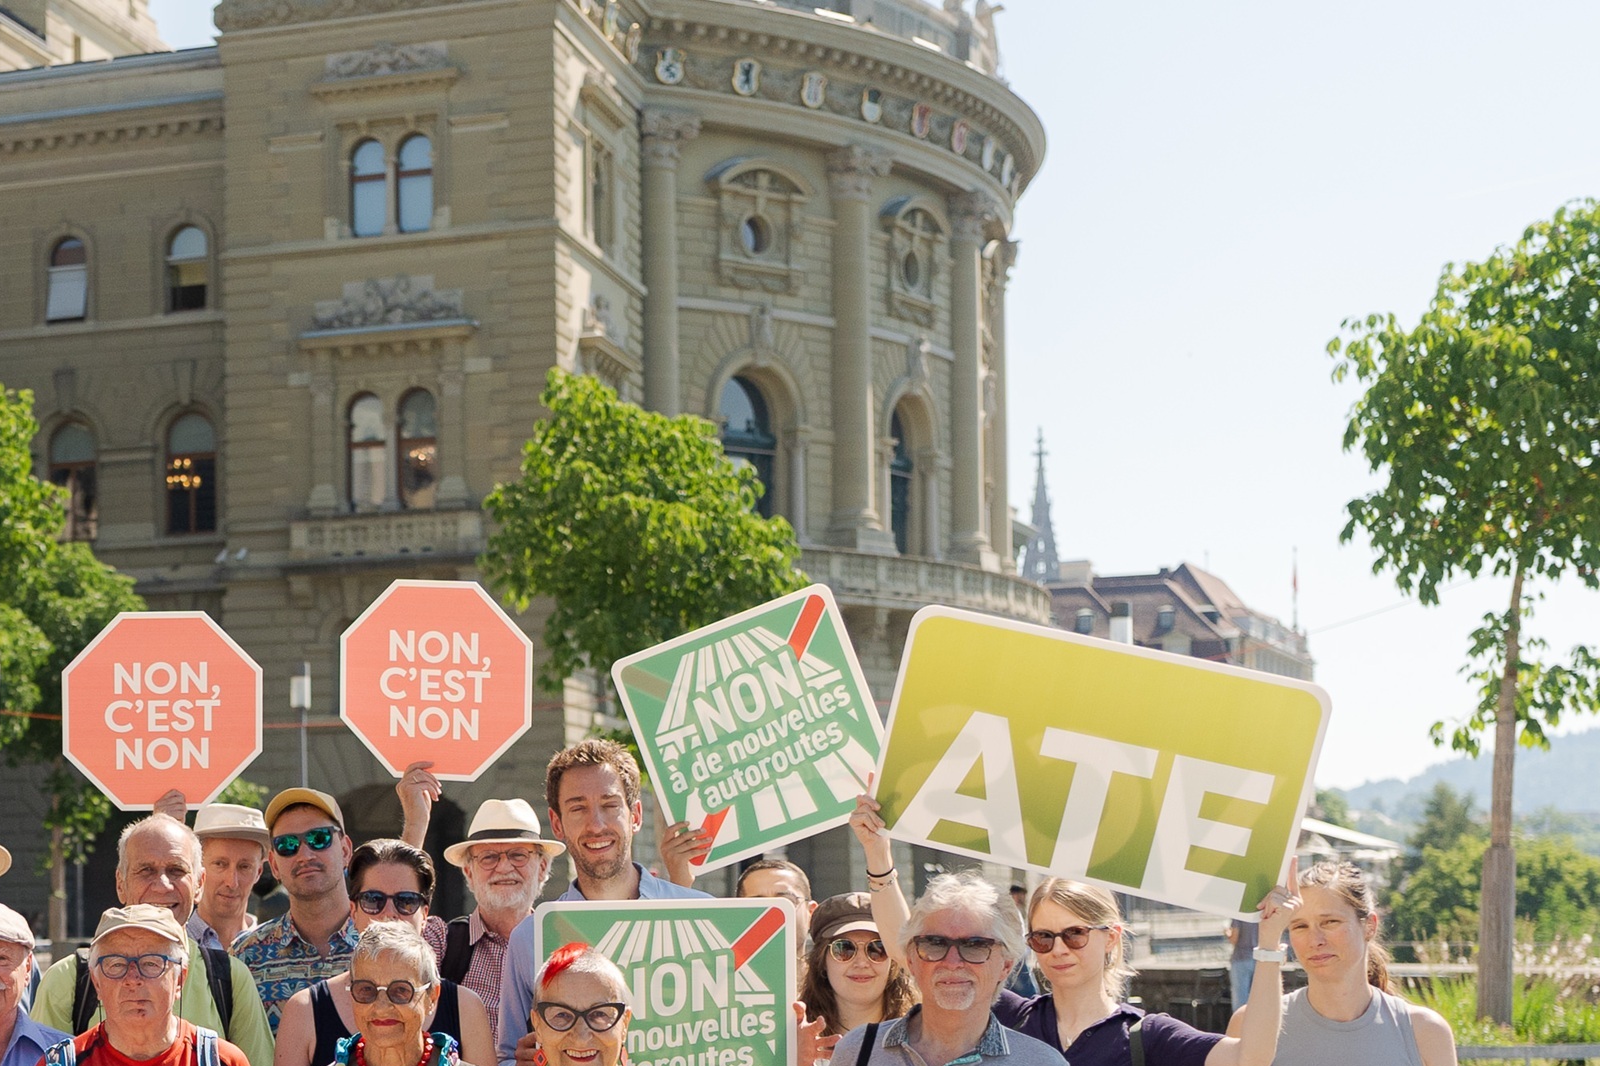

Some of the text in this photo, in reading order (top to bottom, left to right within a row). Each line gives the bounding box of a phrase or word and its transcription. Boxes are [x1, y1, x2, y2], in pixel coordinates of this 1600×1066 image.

[389, 629, 491, 671] NON,
[113, 661, 221, 700] NON,
[379, 667, 491, 703] C'EST
[692, 651, 803, 744] NON
[104, 699, 221, 733] C'EST
[389, 705, 479, 741] NON
[115, 737, 209, 770] NON
[668, 684, 850, 794] à de nouvelles
[703, 721, 843, 809] autoroutes
[889, 711, 1275, 913] ATE
[628, 1008, 776, 1053] nouvelles
